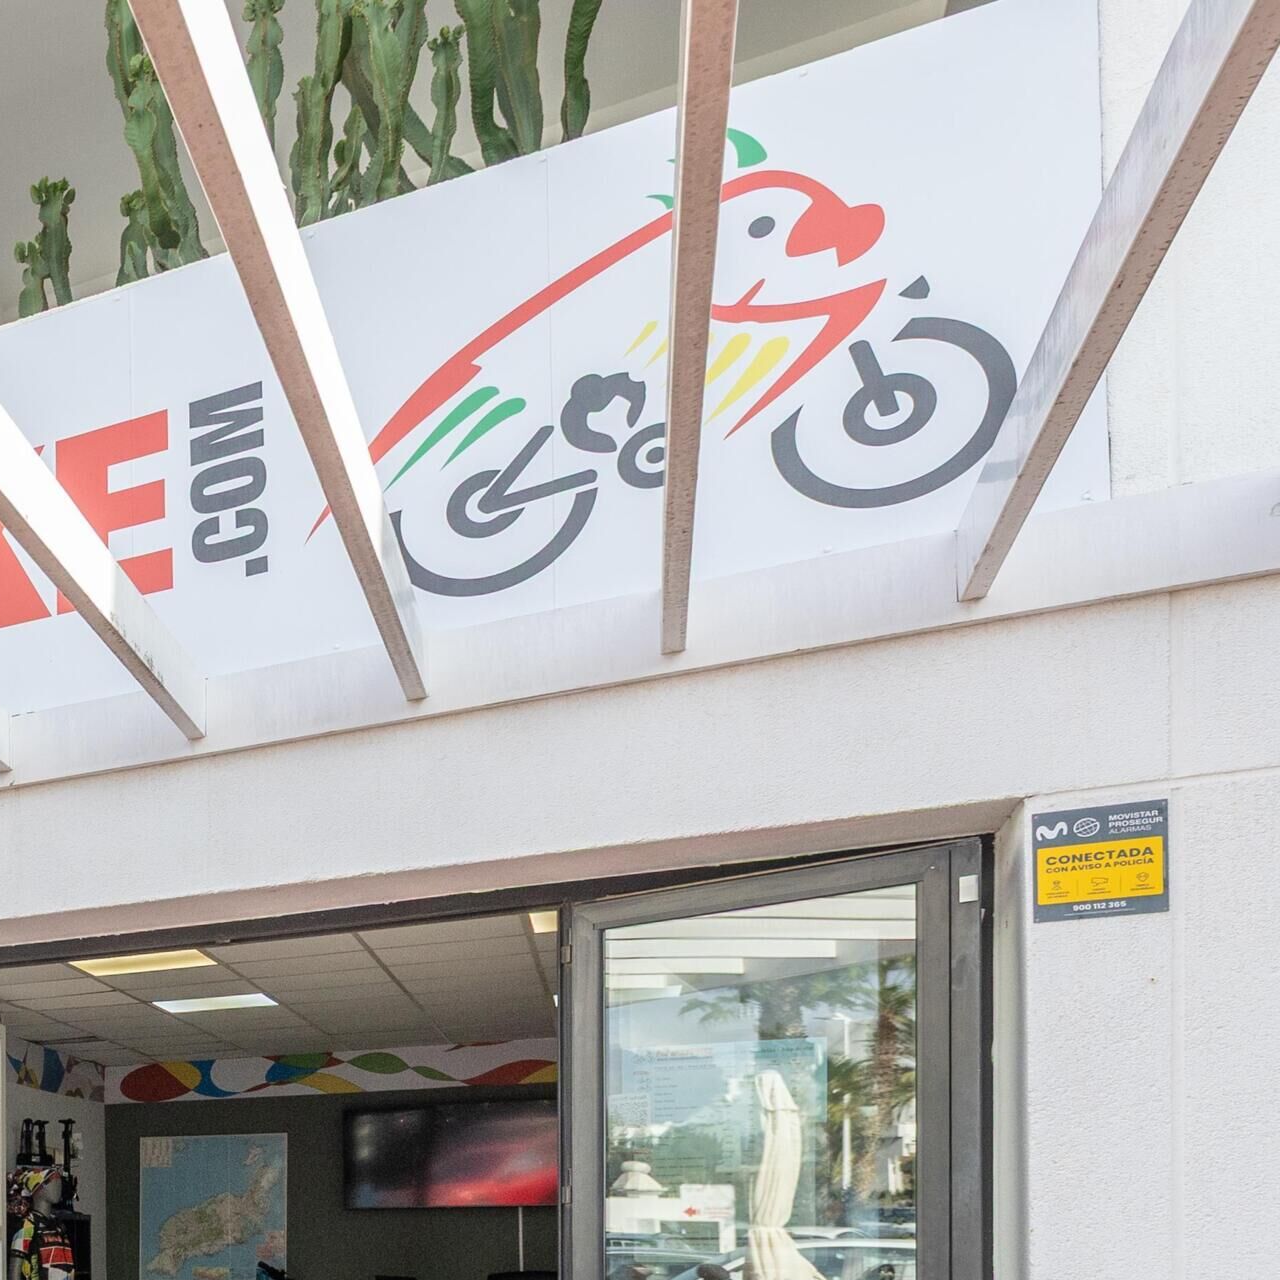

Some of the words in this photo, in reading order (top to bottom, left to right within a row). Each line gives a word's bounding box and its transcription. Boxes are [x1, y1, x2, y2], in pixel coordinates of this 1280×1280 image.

[187, 380, 269, 578] .COM
[1108, 809, 1159, 821] MOVISTAR
[1108, 816, 1164, 828] PROSEGUR
[1108, 825, 1153, 834] ALARMAS
[1046, 846, 1154, 866] CONECTADA
[1045, 866, 1068, 874] CON
[1070, 863, 1102, 872] AVISO
[1113, 857, 1155, 867] POLICÍA
[1073, 902, 1091, 911] 900
[1093, 902, 1106, 910] 112
